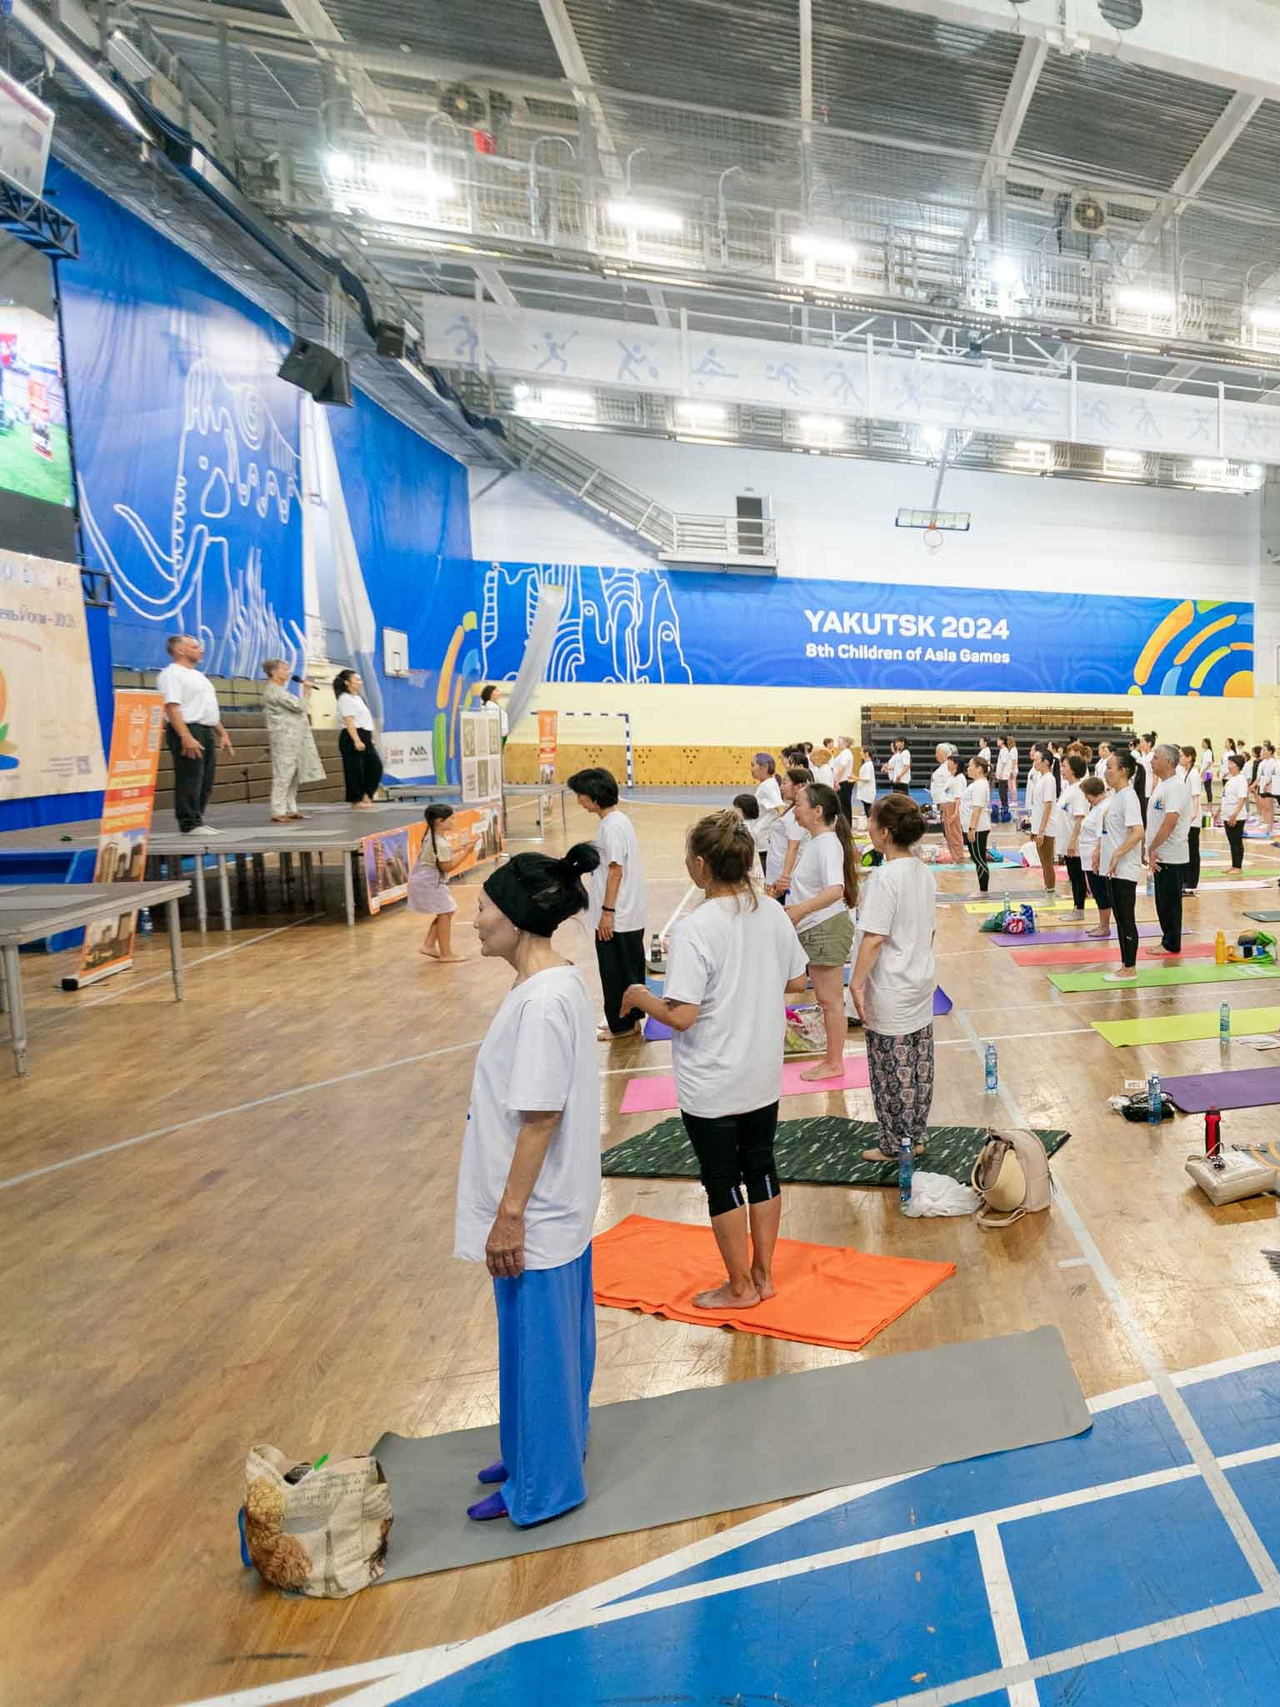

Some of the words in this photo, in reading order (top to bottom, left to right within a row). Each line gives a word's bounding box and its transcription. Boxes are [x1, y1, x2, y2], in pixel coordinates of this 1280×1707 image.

[804, 609, 936, 638] YAKUTSK
[941, 616, 1010, 640] 2024
[805, 643, 835, 659] 8th
[837, 644, 903, 661] Children
[905, 646, 922, 662] of
[924, 648, 957, 662] Asia
[959, 648, 1010, 664] Games
